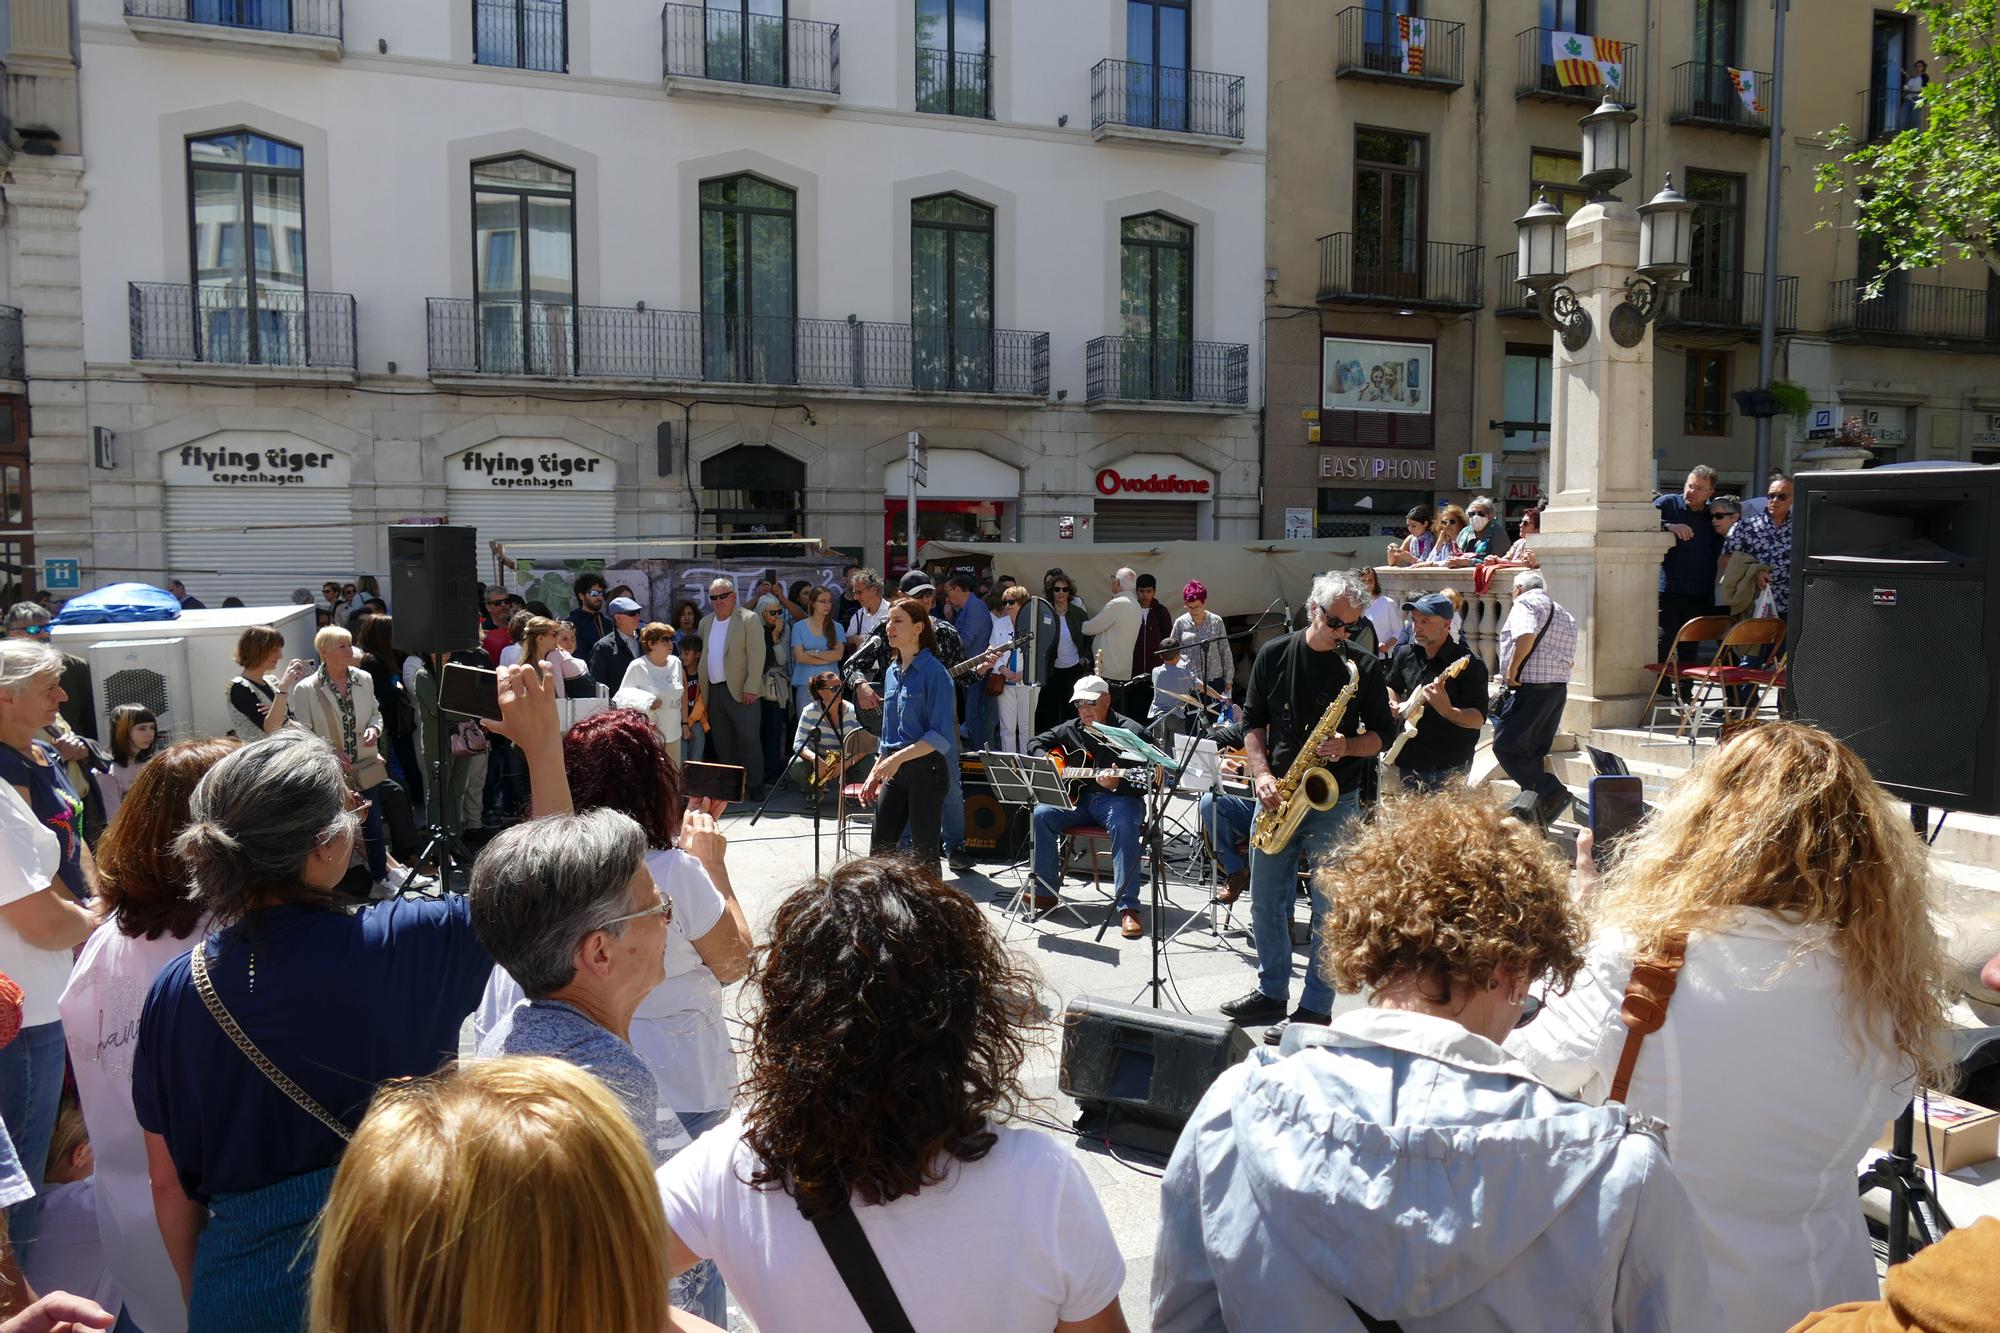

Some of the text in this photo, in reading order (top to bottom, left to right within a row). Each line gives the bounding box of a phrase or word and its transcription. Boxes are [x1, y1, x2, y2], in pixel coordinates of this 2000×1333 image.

[180, 446, 334, 473] flying tiger
[462, 452, 600, 476] flying tiger
[212, 473, 304, 485] copenhagen
[491, 477, 573, 488] copenhagen
